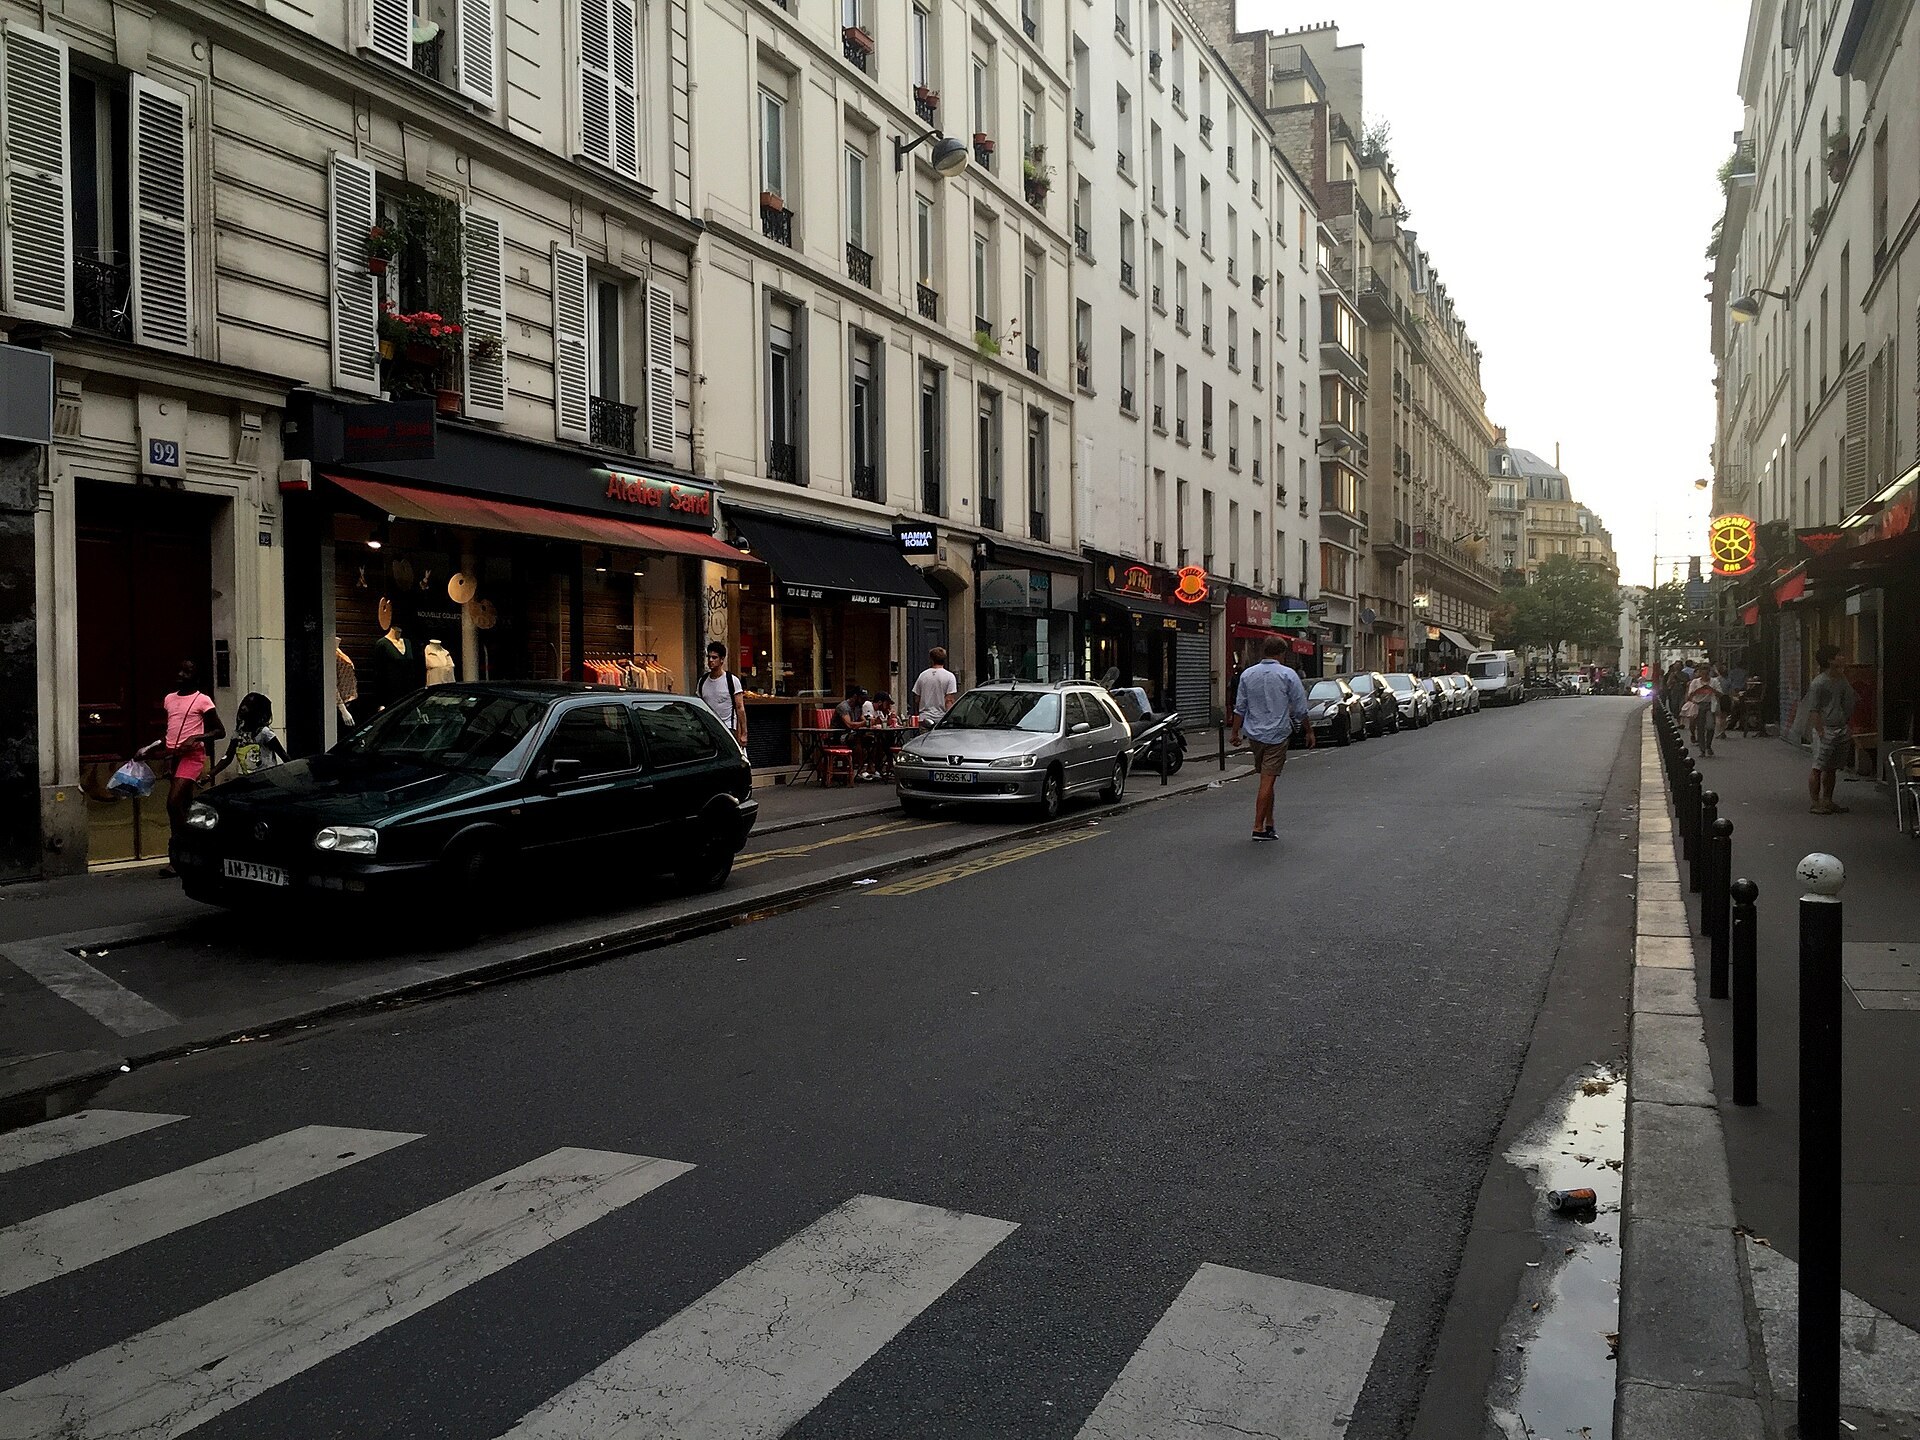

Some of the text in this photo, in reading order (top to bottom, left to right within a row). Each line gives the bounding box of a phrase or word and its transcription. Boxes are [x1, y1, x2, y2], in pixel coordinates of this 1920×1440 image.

[153, 442, 175, 464] 92
[606, 472, 710, 516] Atelier Sand
[900, 531, 933, 540] MAMMA
[904, 539, 929, 547] ROMA
